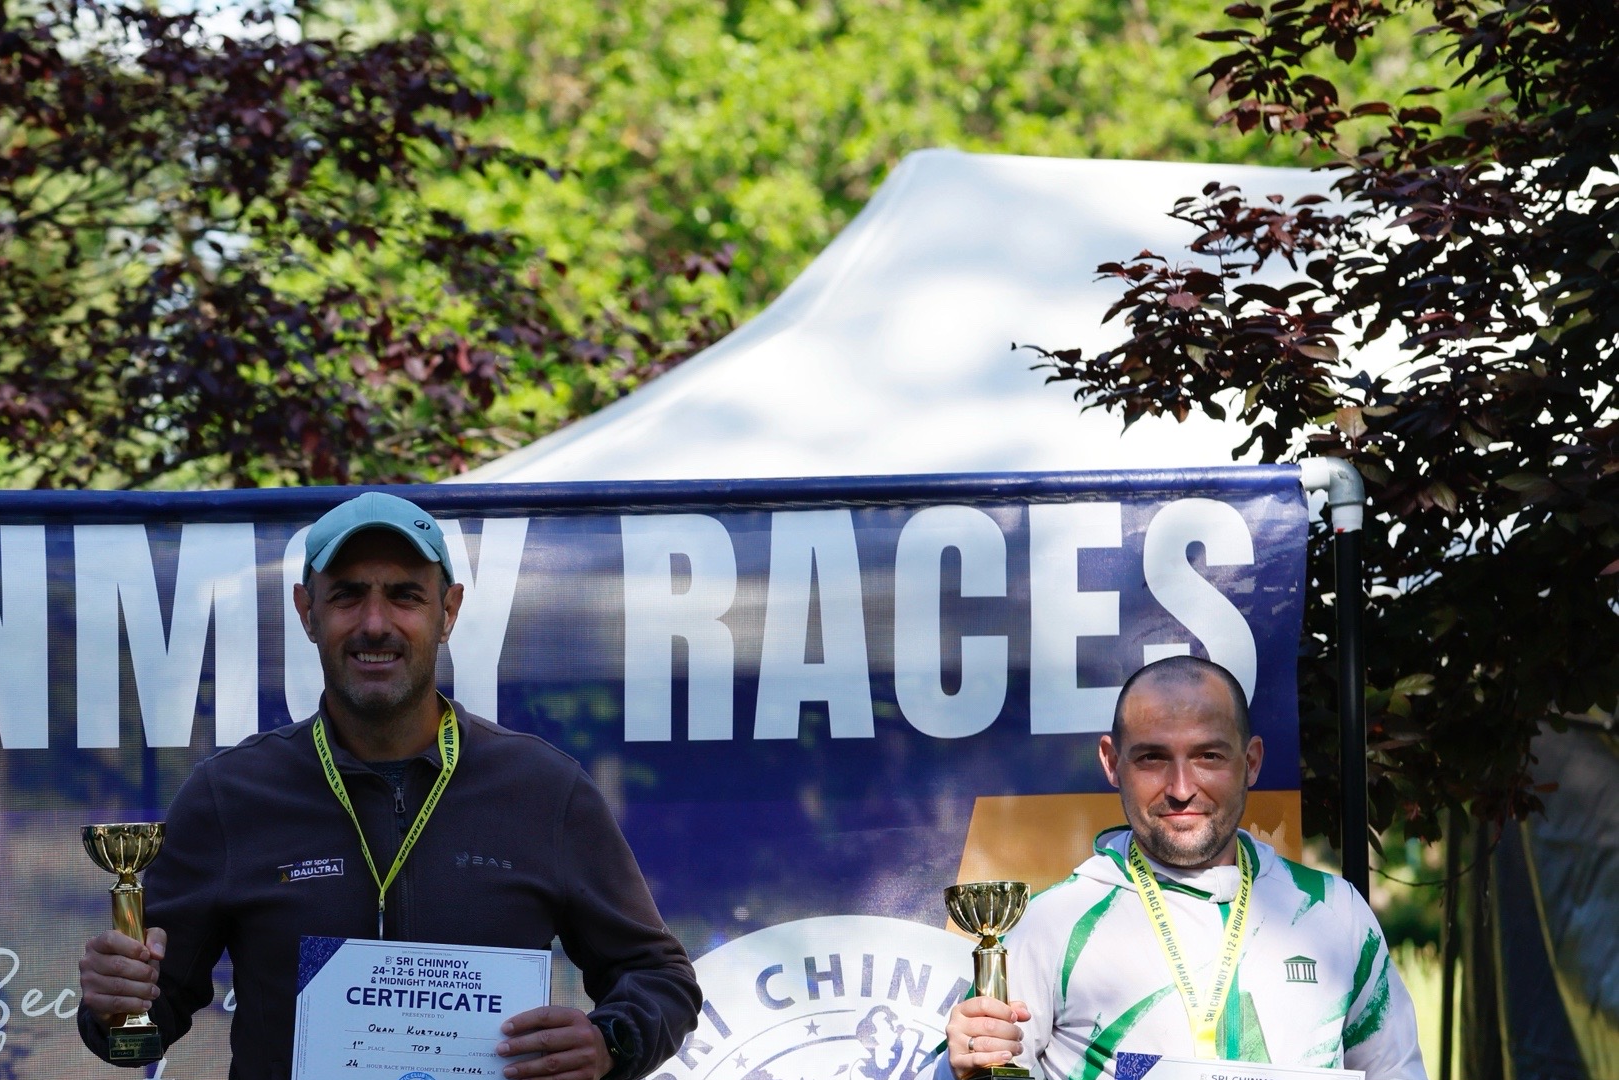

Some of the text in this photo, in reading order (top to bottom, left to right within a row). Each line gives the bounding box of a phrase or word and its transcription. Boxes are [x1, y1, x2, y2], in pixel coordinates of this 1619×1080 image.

[620, 498, 1258, 743] RACES
[424, 775, 447, 816] MIDNIGHT
[398, 816, 425, 863] MARATHON
[1136, 865, 1151, 889] HOUR
[1145, 888, 1162, 913] RACE
[1239, 885, 1248, 908] RACE
[1155, 913, 1164, 921] &
[1232, 907, 1245, 934] HOUR
[1158, 920, 1181, 964] MIDNIGHT
[1221, 932, 1239, 968] 24-12-6
[372, 966, 481, 980] 24-12-6 HOUR RACE
[396, 956, 413, 966] SRI
[417, 957, 469, 969] CHINMOY
[370, 976, 481, 990] & MIDNIGHT MARATHON
[754, 952, 974, 1017] CHIN
[1175, 963, 1199, 1008] MARATHON
[1210, 969, 1229, 1009] CHINMOY
[346, 986, 502, 1014] CERTIFICATE
[1204, 1008, 1217, 1023] SRI
[368, 1023, 395, 1034] OKAN
[411, 1044, 430, 1052] TOP
[435, 1046, 441, 1054] 3
[346, 1059, 358, 1067] 24
